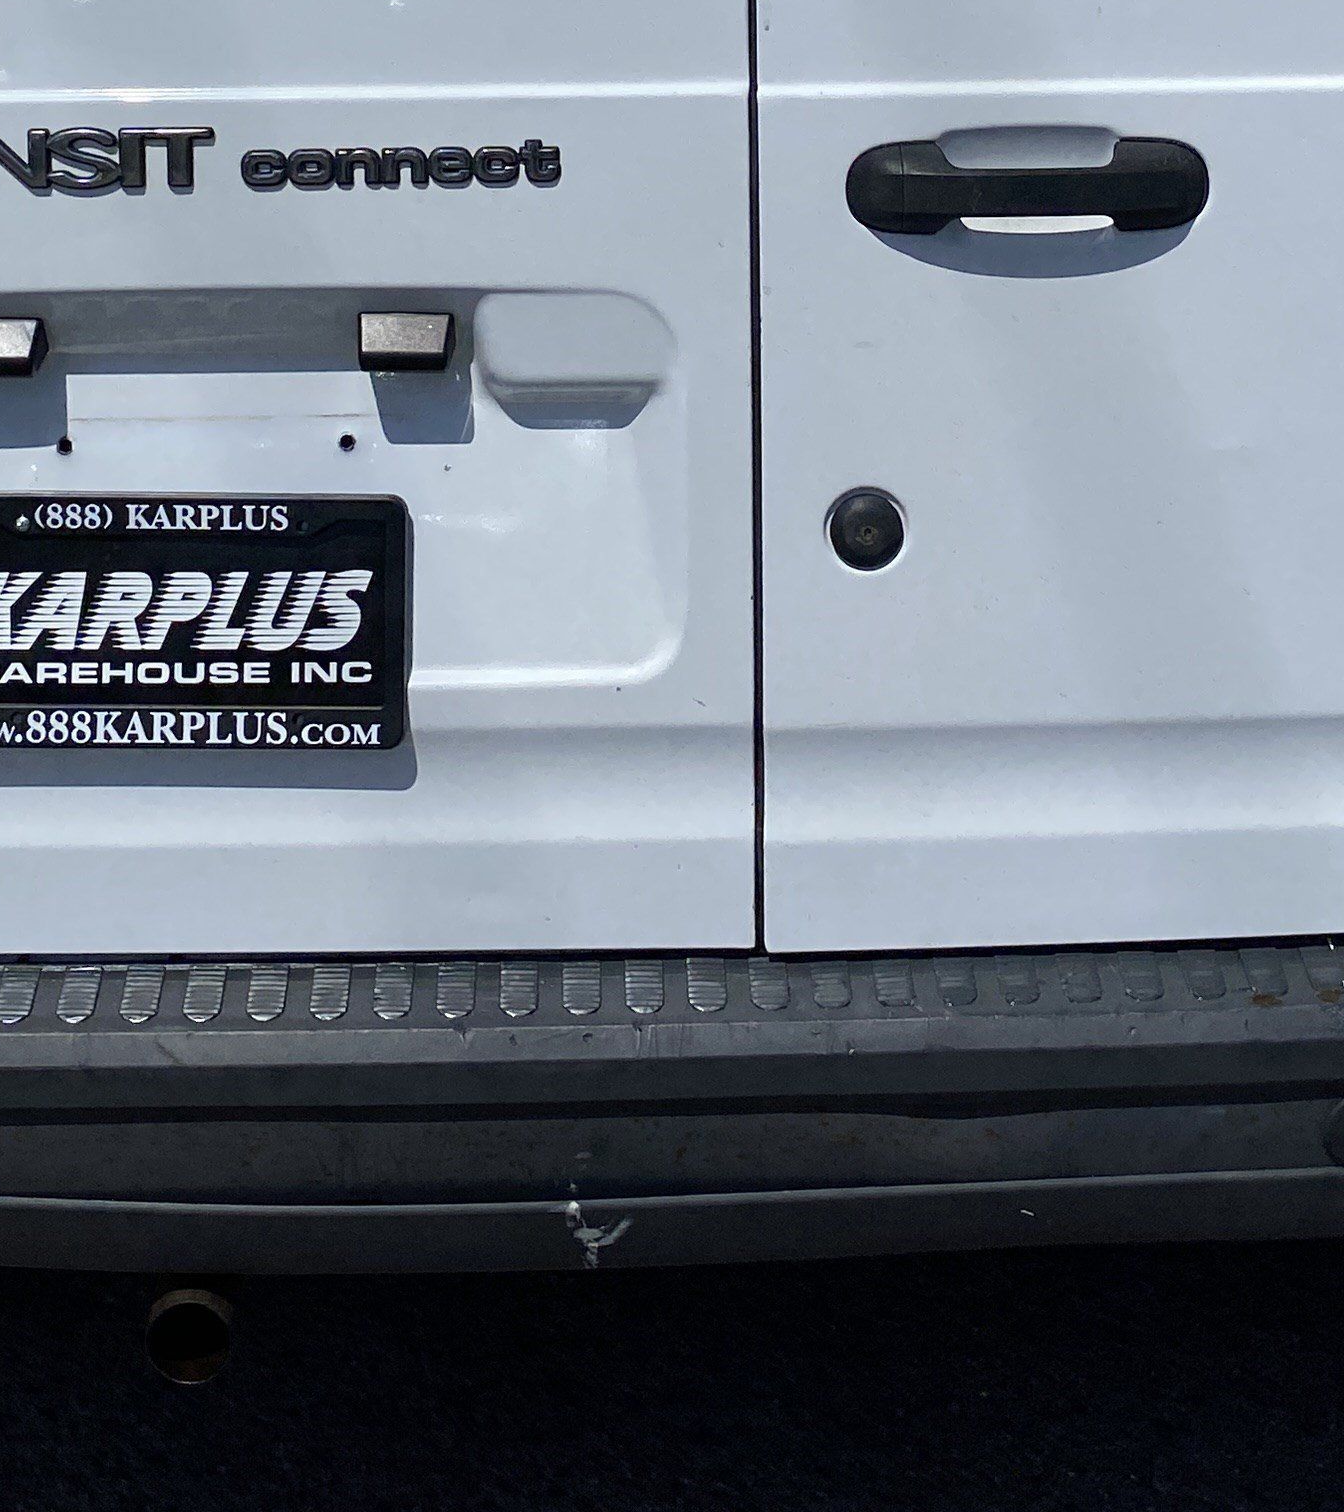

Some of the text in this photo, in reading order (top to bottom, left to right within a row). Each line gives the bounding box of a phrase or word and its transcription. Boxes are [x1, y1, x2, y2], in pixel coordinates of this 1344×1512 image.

[241, 139, 560, 190] connect
[34, 503, 289, 531] (888) KARPLUS
[290, 661, 373, 684] INC
